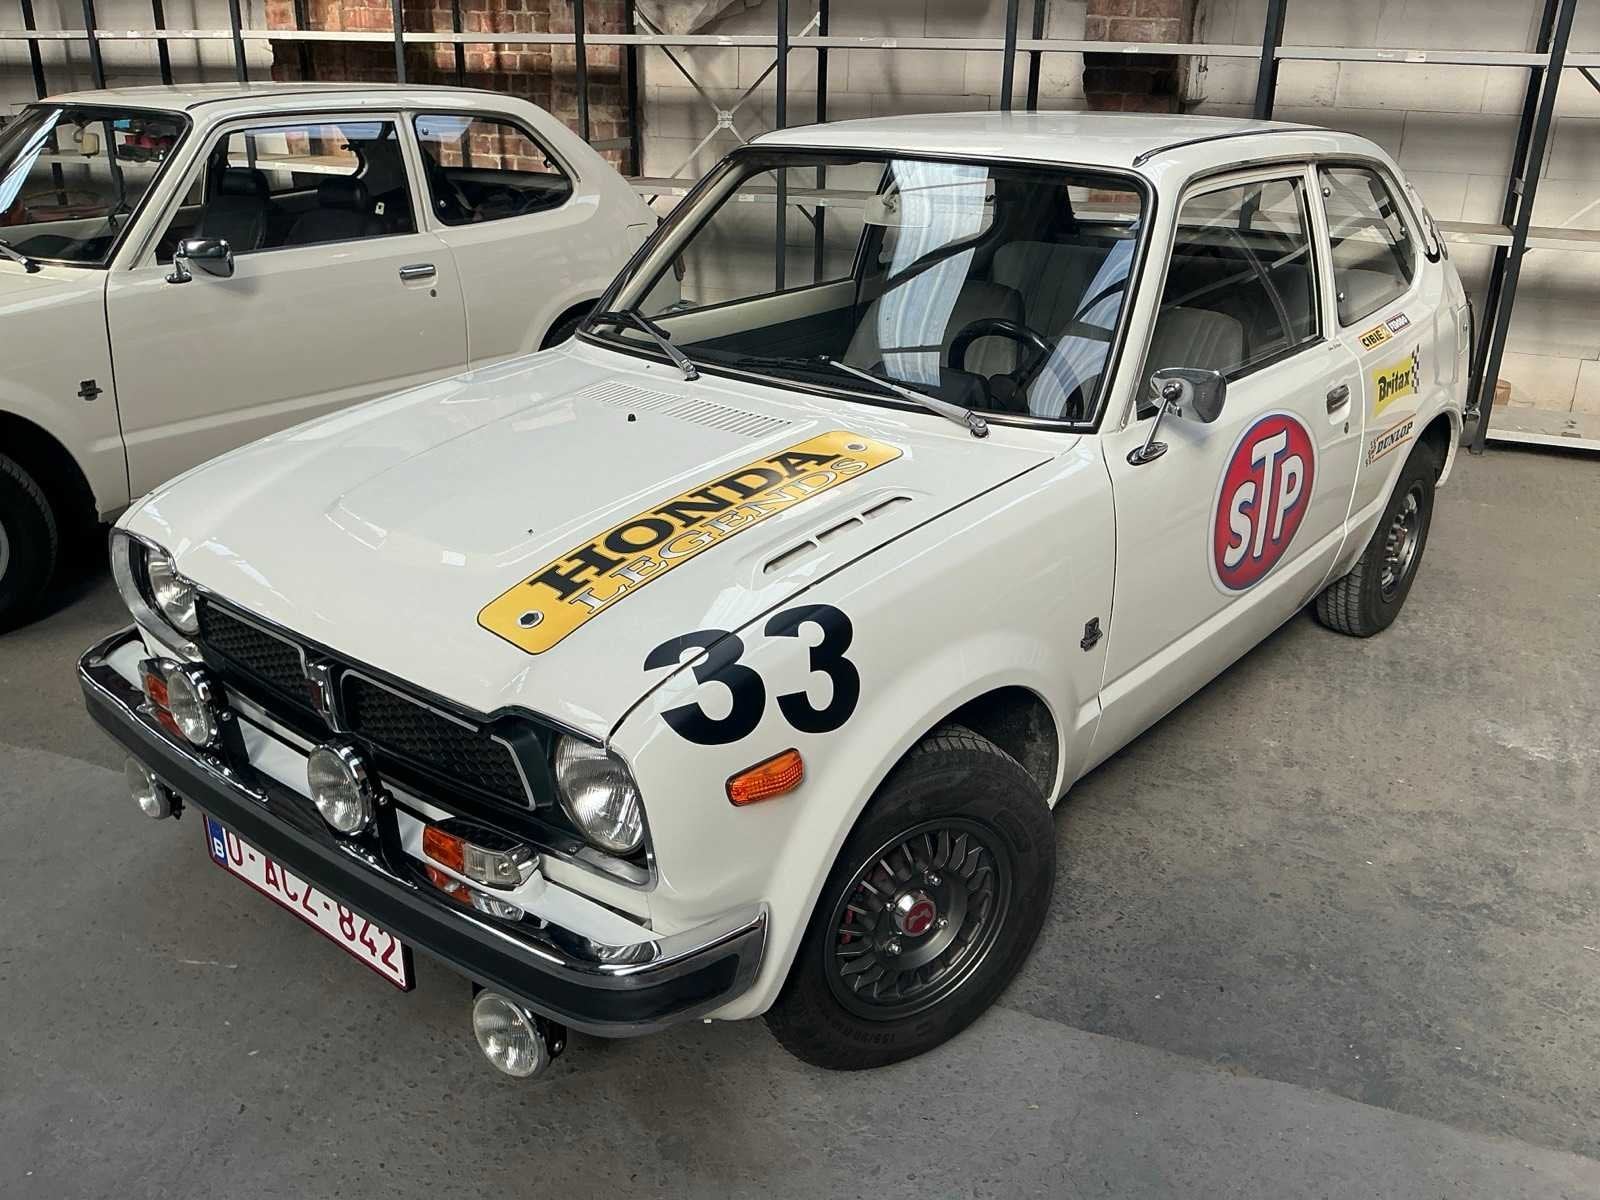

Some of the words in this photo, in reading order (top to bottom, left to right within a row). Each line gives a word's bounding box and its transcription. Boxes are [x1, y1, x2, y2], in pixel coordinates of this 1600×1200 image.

[1361, 330, 1385, 348] CIBIE
[1378, 370, 1411, 402] Britax
[1223, 429, 1305, 569] STP
[1375, 420, 1414, 454] DUNLOP
[526, 449, 843, 602] HONDA
[568, 456, 871, 615] LEGENDS
[643, 603, 861, 746] 33
[213, 837, 225, 858] B
[226, 830, 399, 974] U-ACZ-842
